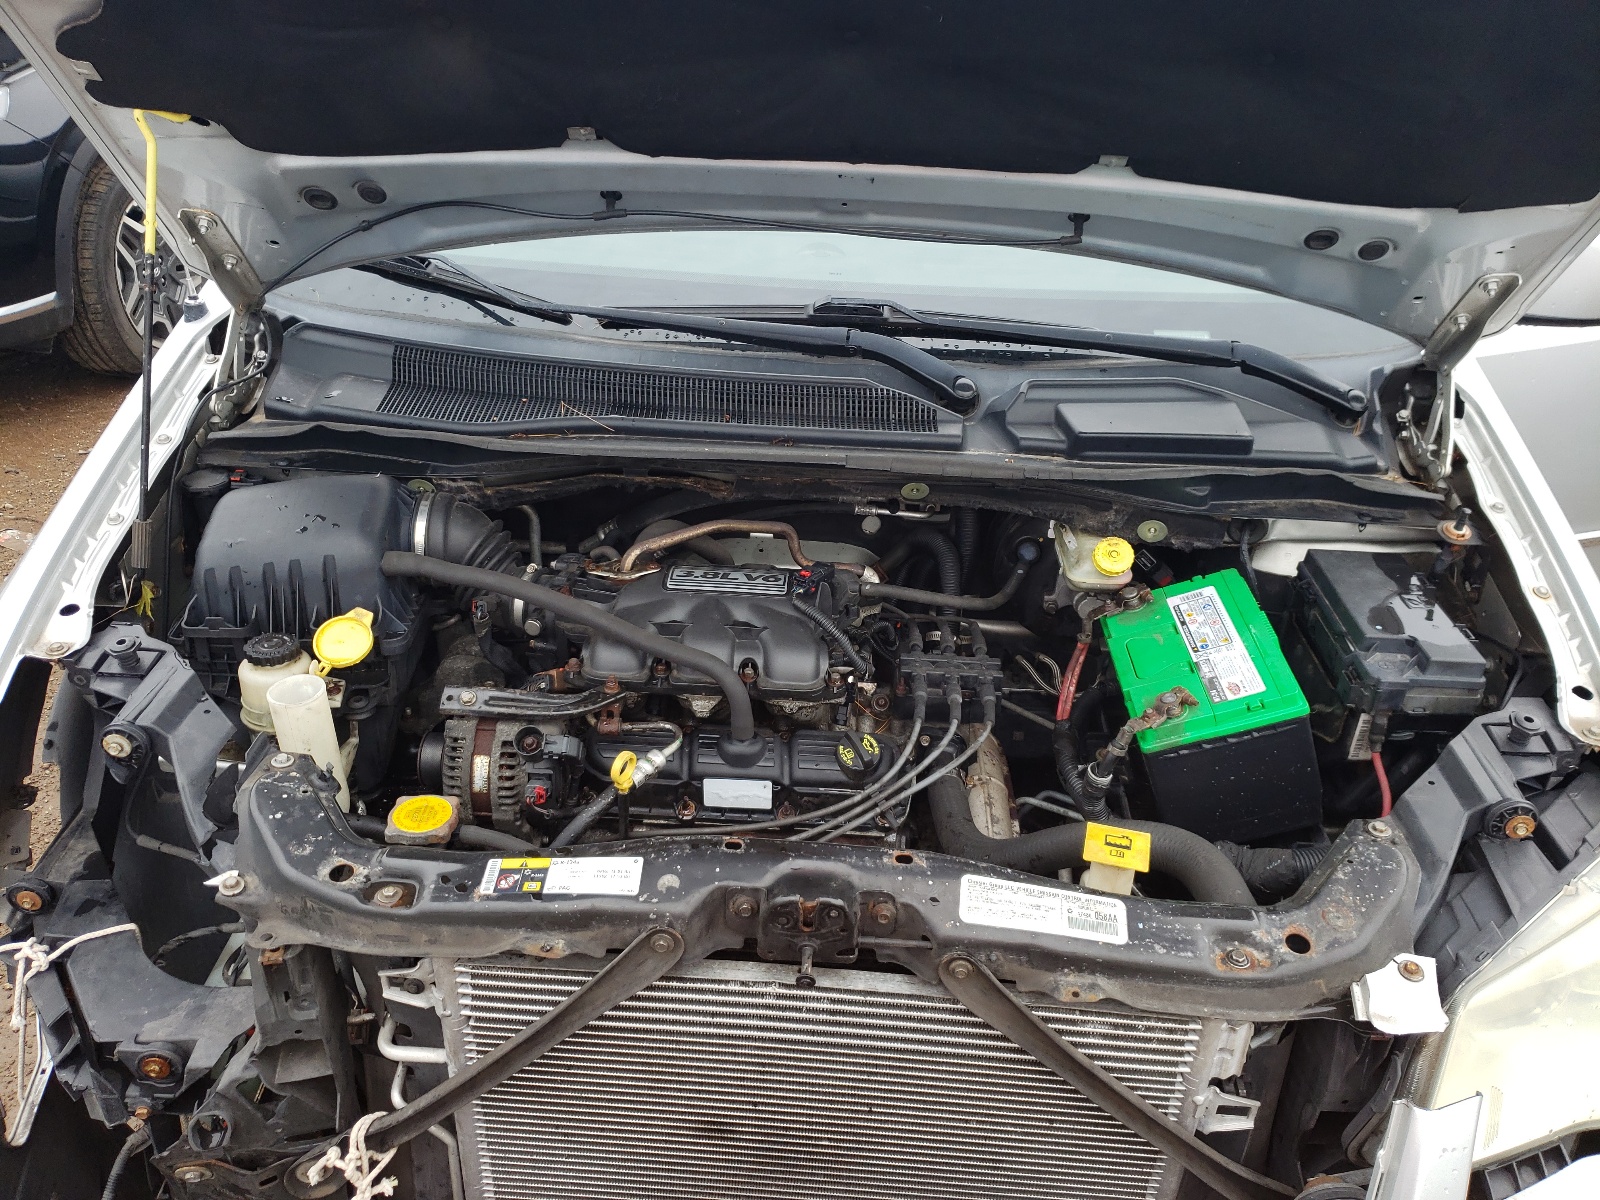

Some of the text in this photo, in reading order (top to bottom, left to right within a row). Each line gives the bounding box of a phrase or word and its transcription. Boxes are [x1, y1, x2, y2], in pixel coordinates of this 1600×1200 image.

[676, 570, 782, 583] 3.8L V6
[1016, 886, 1036, 895] VEHICLE
